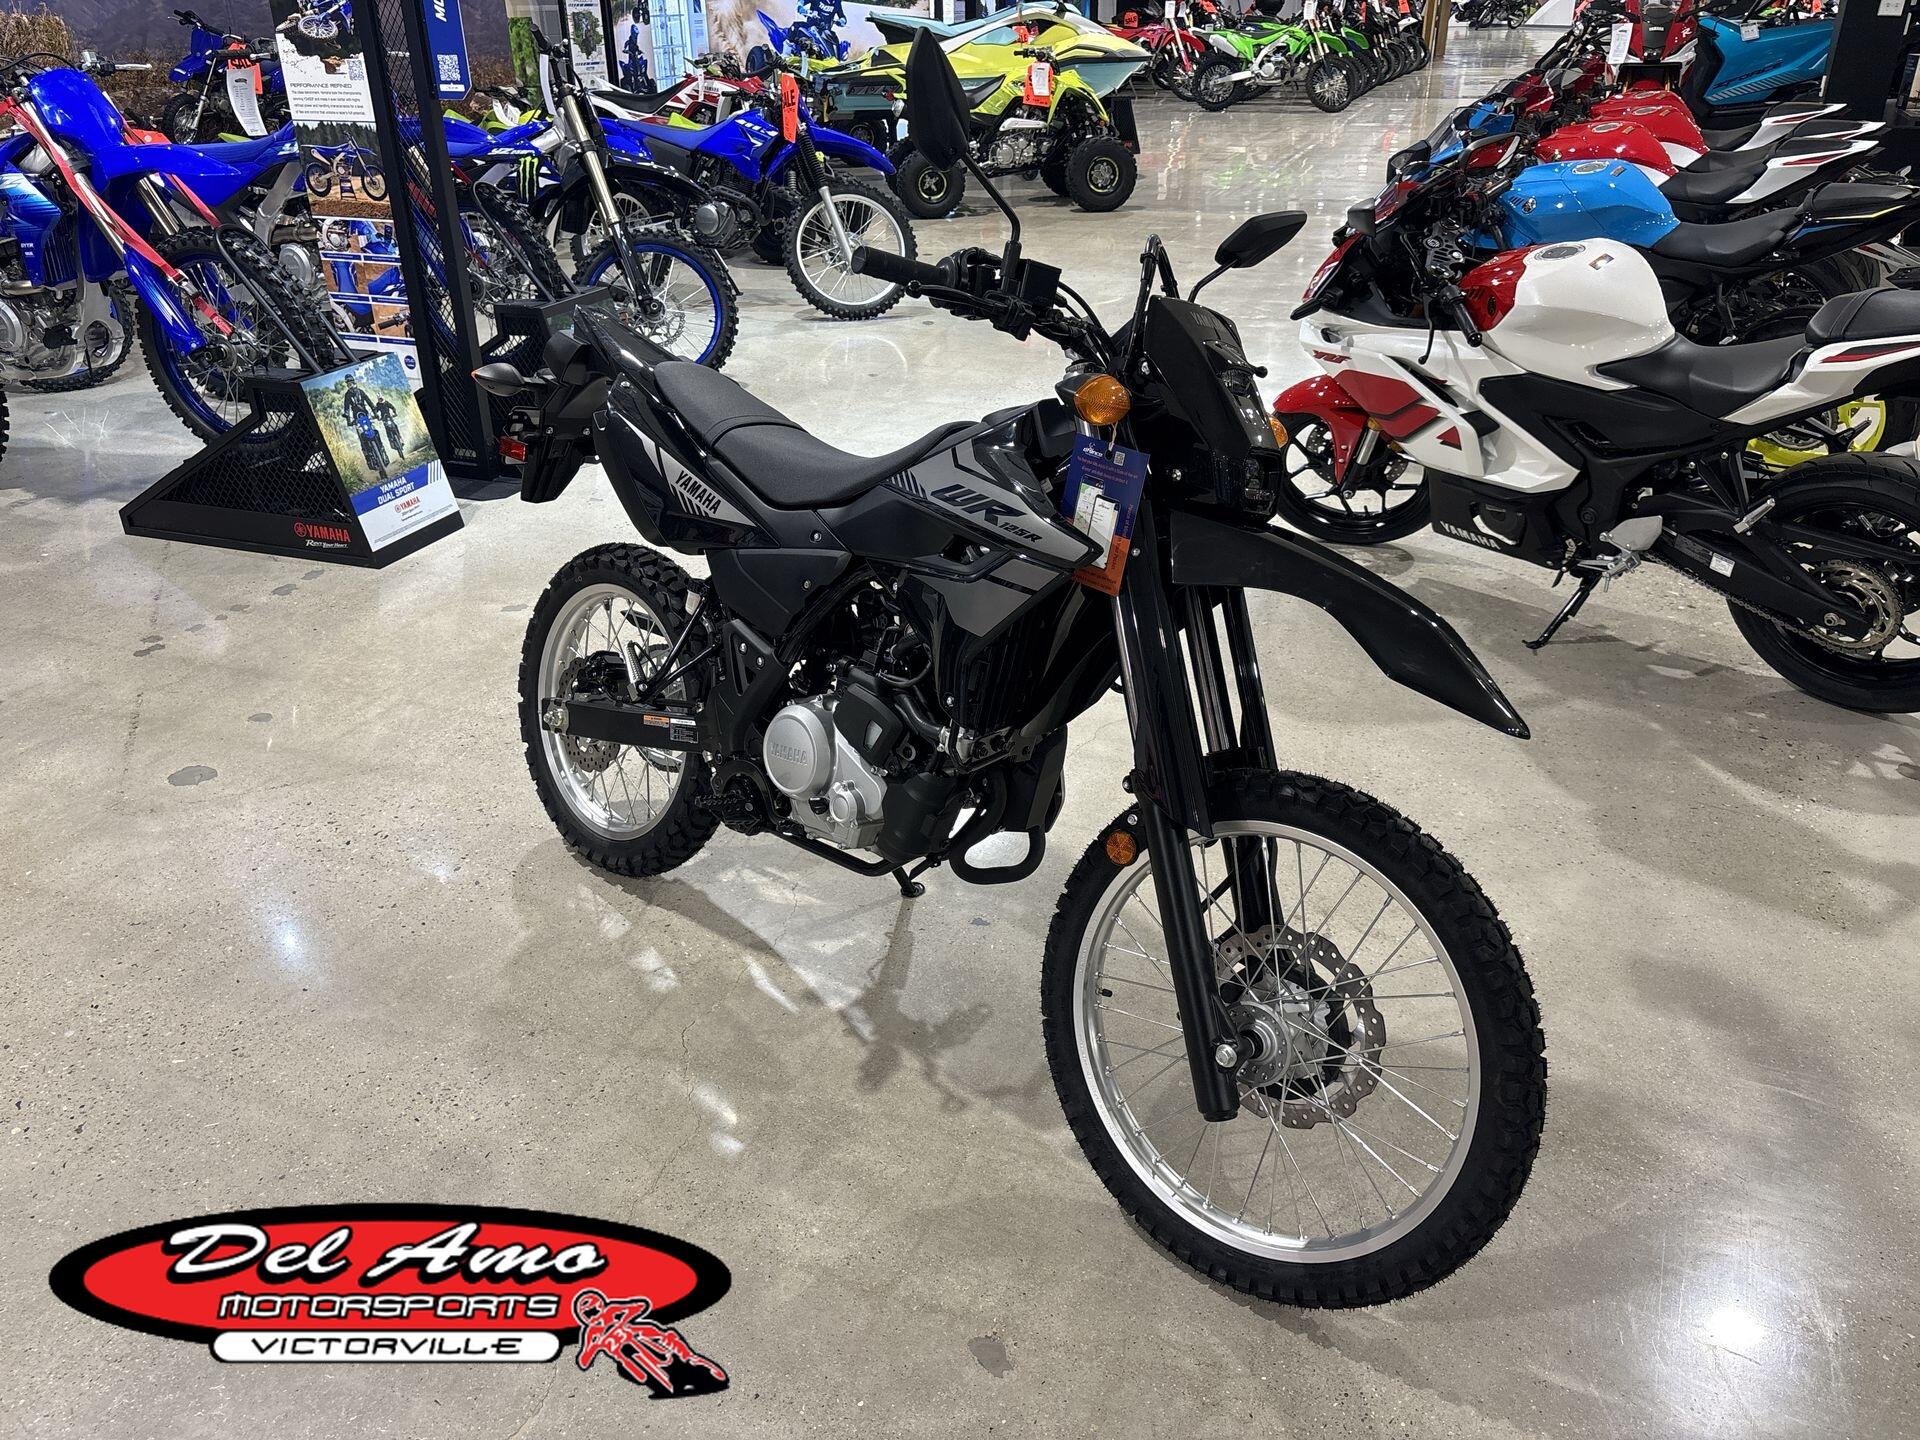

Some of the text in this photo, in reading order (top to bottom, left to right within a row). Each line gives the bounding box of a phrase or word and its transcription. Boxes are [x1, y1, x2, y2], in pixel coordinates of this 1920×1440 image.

[377, 481, 415, 505] DUAL SPORT
[380, 476, 407, 493] YAMAHA
[675, 470, 722, 515] YAMAHA
[399, 496, 421, 510] YAMAHA
[306, 524, 352, 543] YAMAHA
[1440, 520, 1501, 550] YAMAHA
[769, 742, 808, 766] YAMAHA
